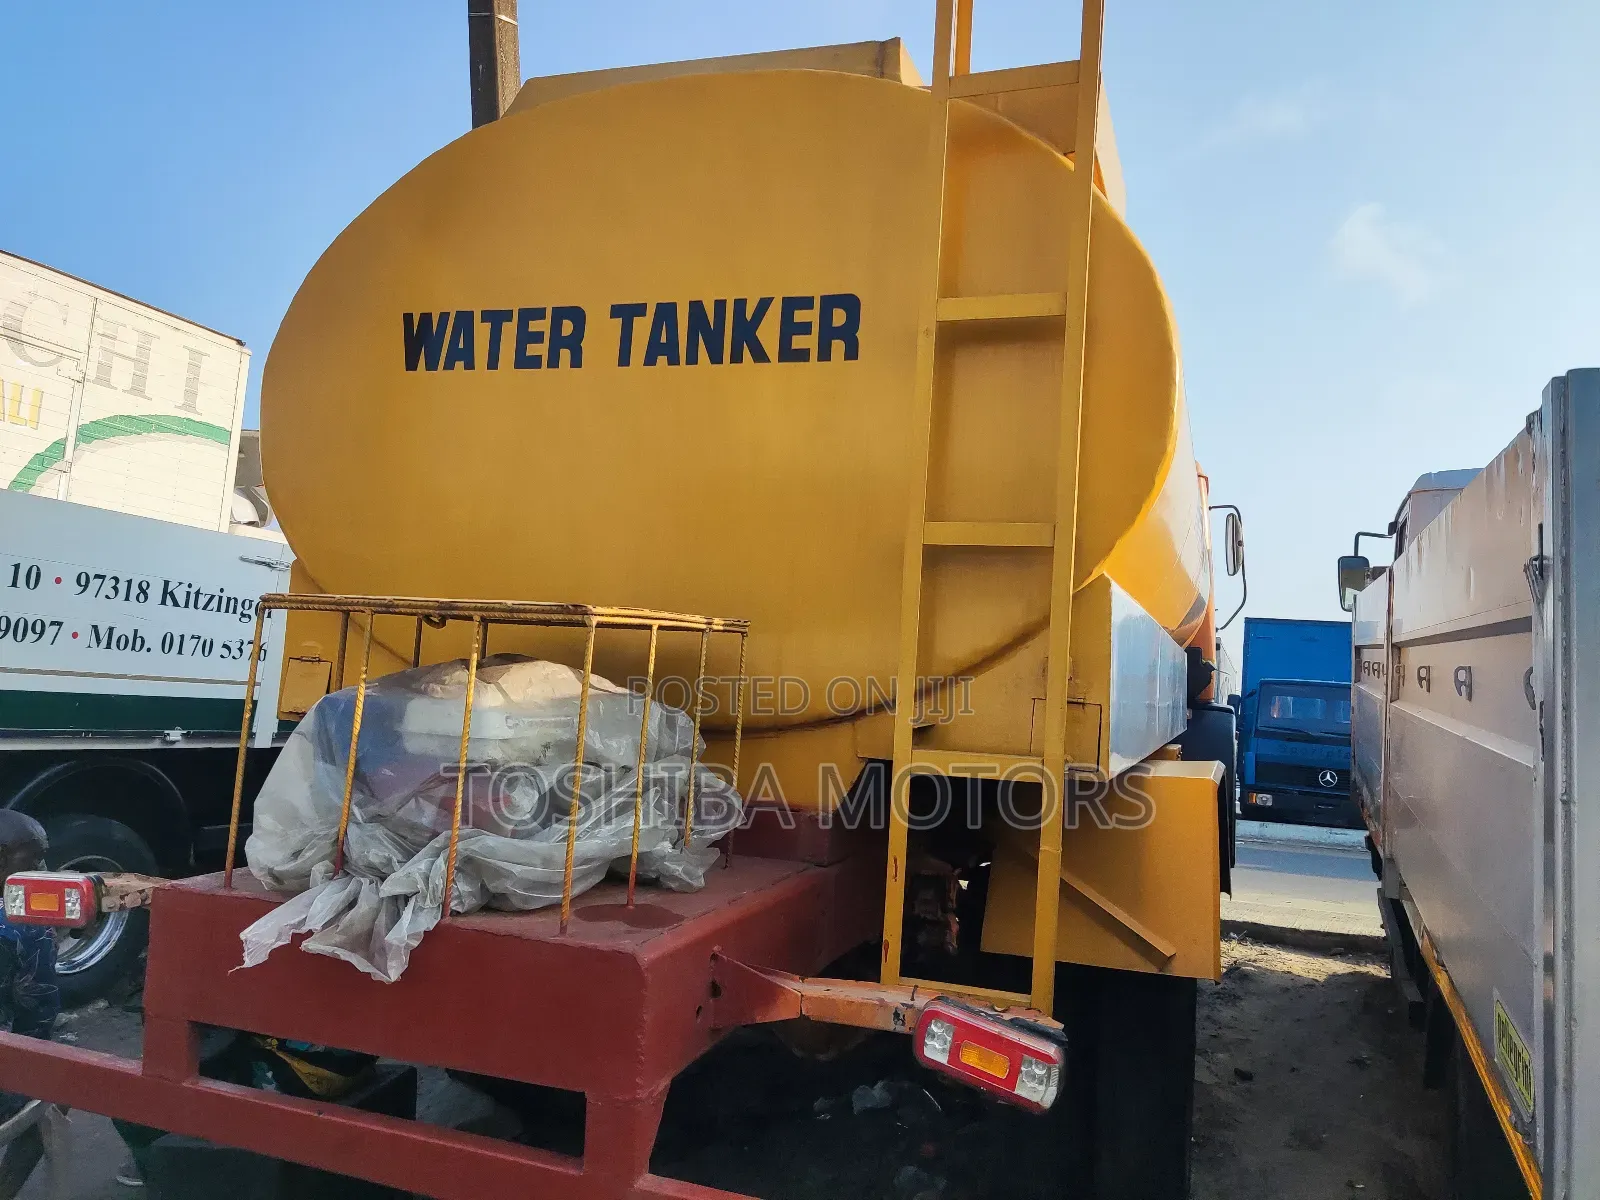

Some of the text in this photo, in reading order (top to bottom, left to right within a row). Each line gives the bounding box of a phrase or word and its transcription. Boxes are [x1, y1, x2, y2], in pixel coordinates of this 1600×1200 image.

[402, 293, 861, 372] WATER TANKER
[7, 562, 42, 591] 10
[74, 571, 150, 604] 97318
[85, 624, 152, 653] Mob.
[161, 631, 214, 658] 0170
